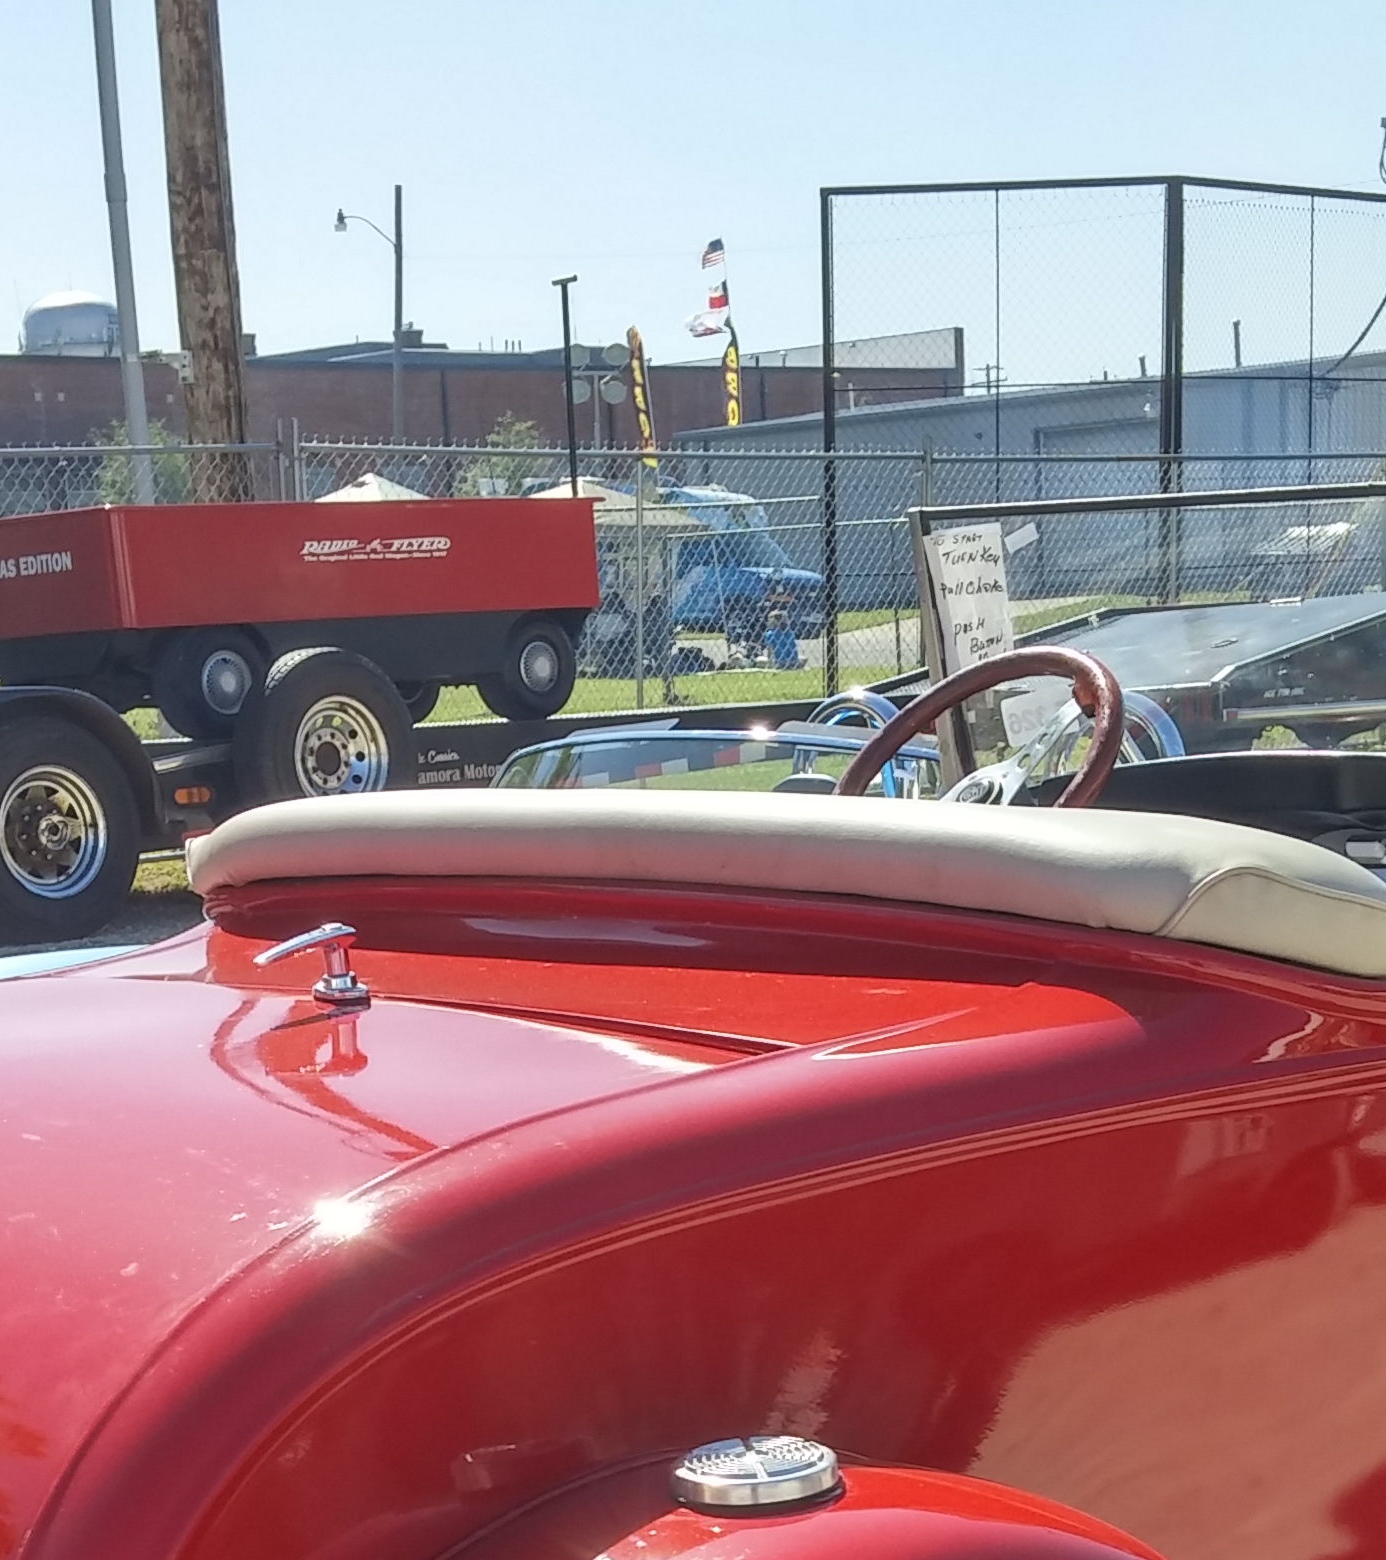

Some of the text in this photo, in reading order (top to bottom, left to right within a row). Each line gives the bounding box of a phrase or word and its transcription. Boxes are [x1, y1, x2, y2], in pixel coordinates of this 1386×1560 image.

[299, 536, 452, 555] RADIO FLYER
[18, 550, 73, 576] EDITION
[417, 767, 462, 785] amora
